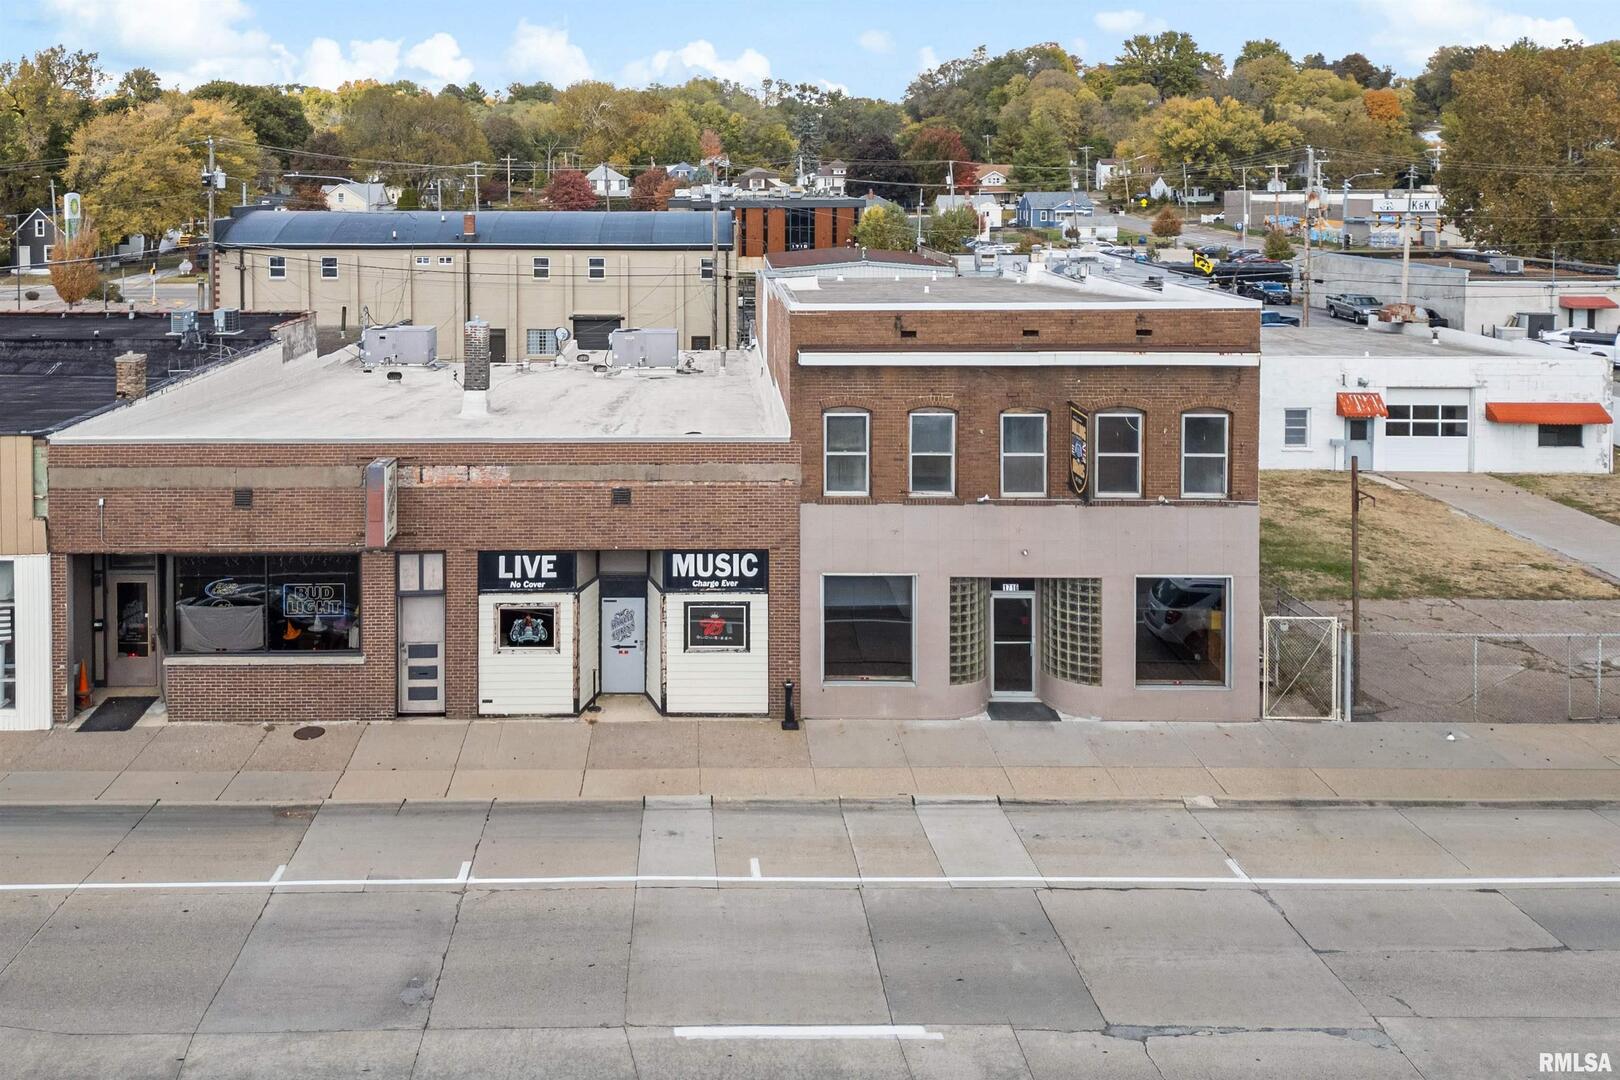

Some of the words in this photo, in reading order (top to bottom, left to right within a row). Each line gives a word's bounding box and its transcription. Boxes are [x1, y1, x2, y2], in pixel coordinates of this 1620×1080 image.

[498, 555, 557, 579] LIVE
[672, 553, 759, 578] MUSIC
[523, 580, 546, 588] Cover
[692, 580, 719, 588] Charge
[295, 585, 335, 600] BUD
[287, 600, 342, 615] LIGHT
